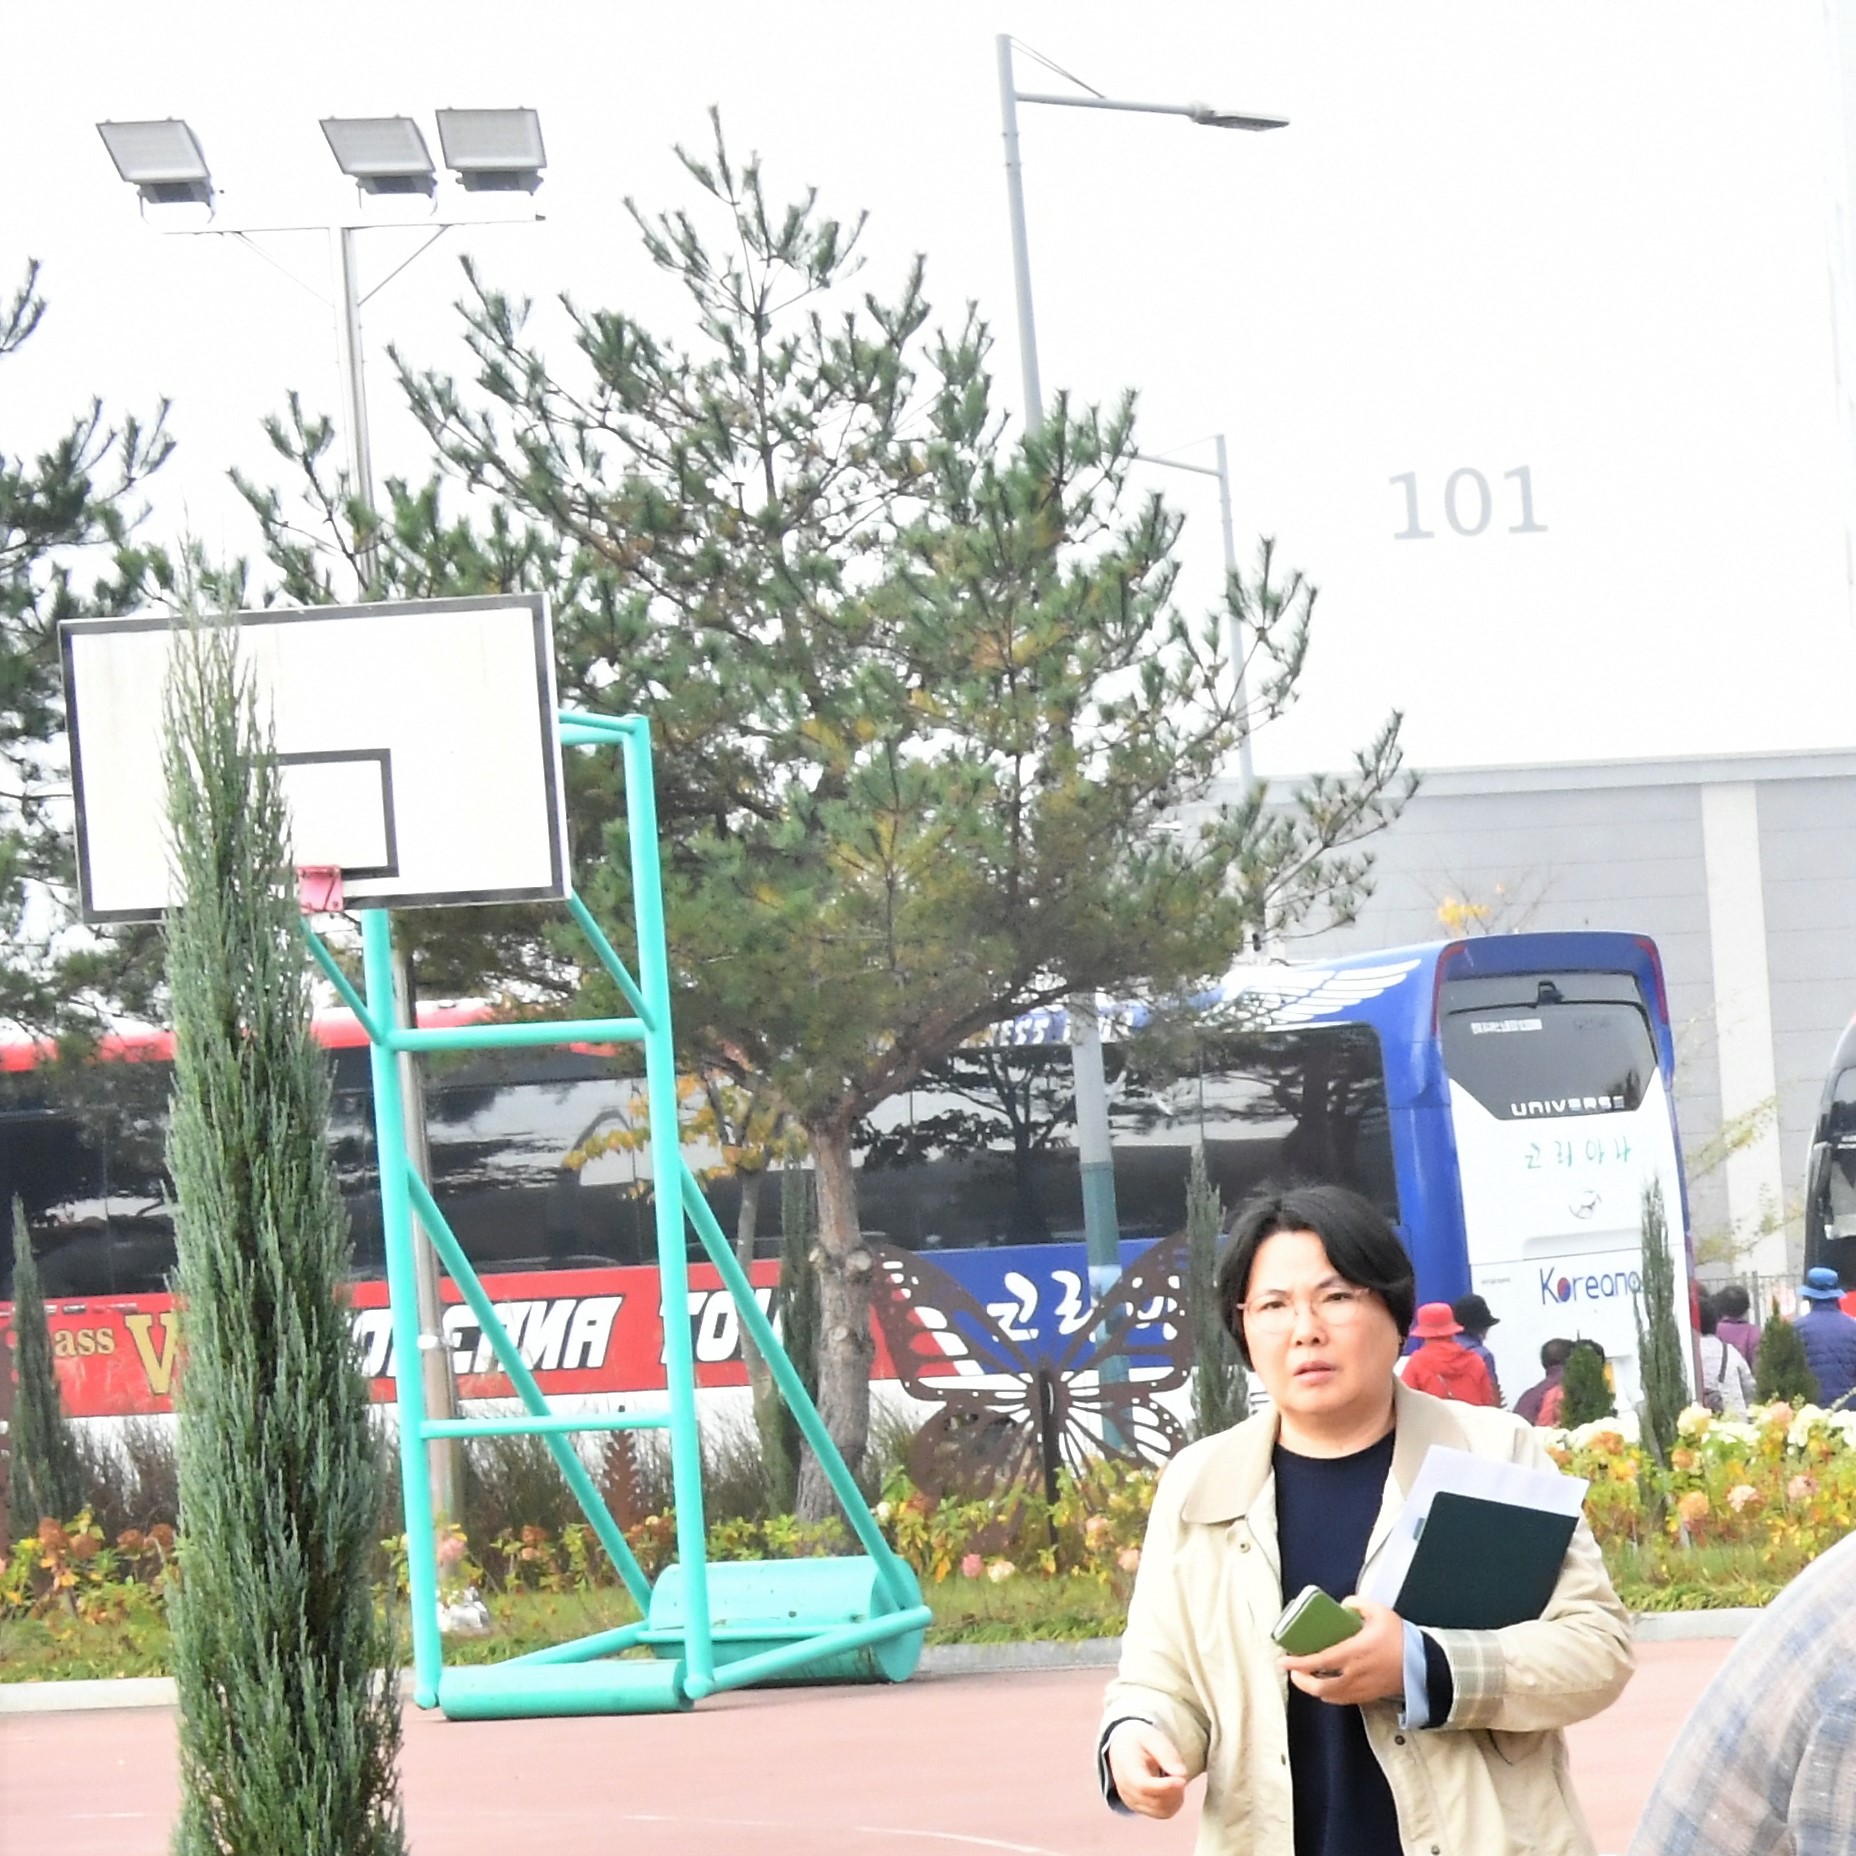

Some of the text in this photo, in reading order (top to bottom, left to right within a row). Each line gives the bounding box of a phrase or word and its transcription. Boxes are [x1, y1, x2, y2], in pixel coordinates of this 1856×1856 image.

[1389, 464, 1549, 541] 101
[1511, 1095, 1626, 1117] UNIVERSE
[1539, 1266, 1643, 1305] Koreana
